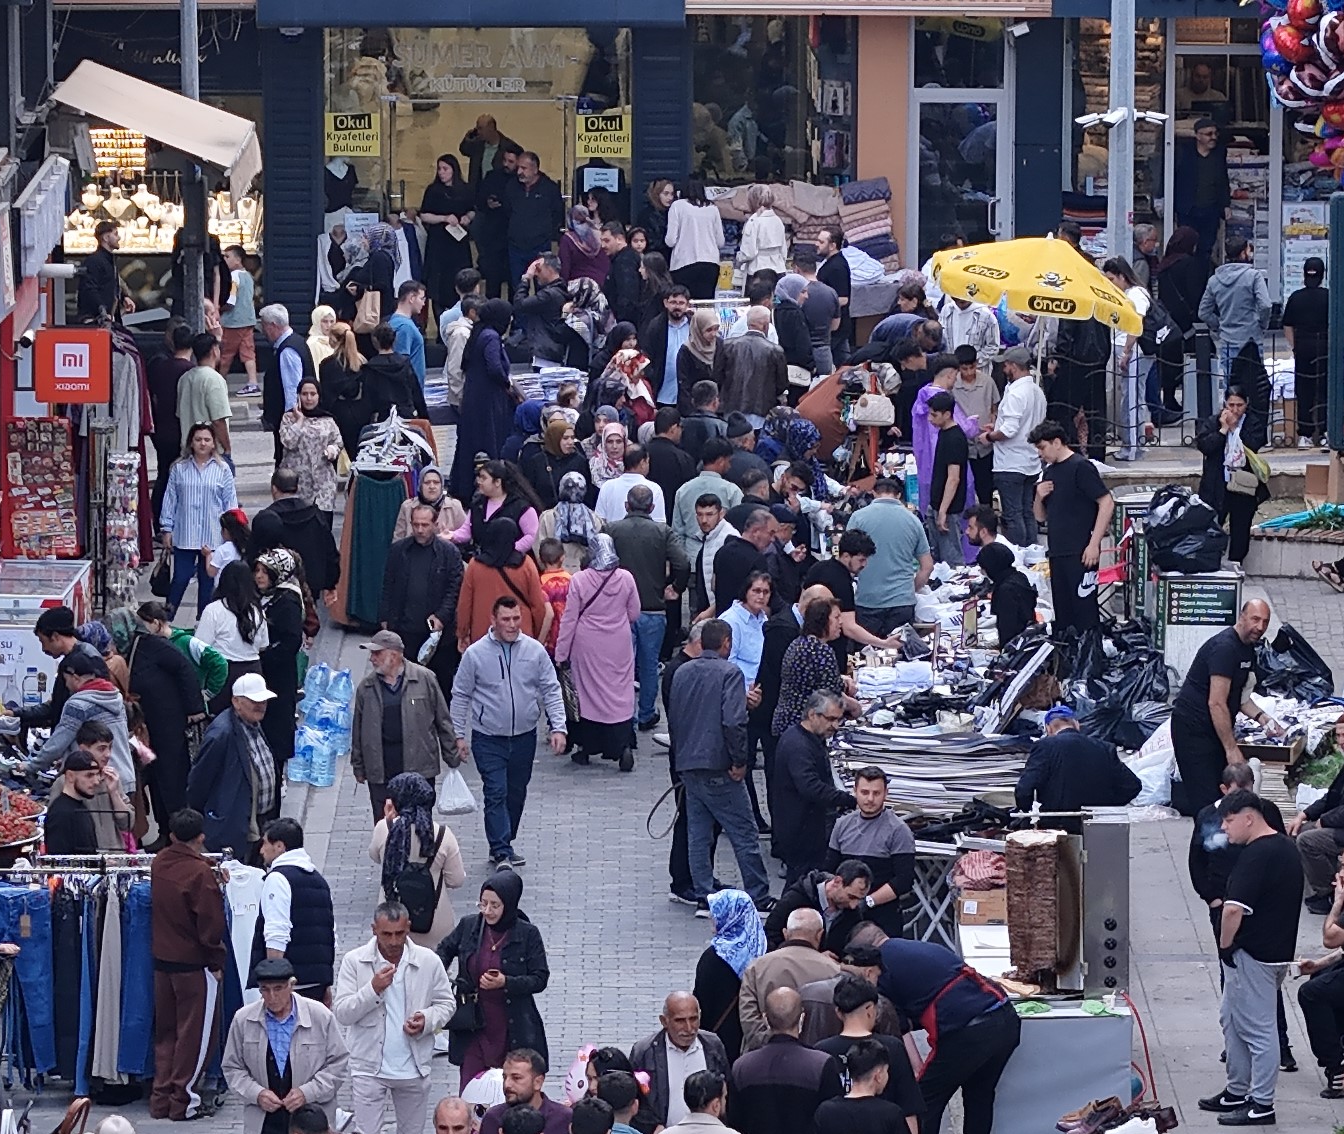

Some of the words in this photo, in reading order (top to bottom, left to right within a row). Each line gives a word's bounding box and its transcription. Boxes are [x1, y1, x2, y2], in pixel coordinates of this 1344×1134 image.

[393, 40, 493, 69] SÜMER
[498, 44, 566, 69] AVM
[429, 74, 528, 93] KÜTÜKLER
[336, 114, 370, 130] Okul
[587, 117, 621, 131] Okul
[326, 131, 379, 144] Kıyafetleri
[577, 132, 630, 145] Kıyafetleri
[333, 143, 372, 154] Bulunur
[583, 145, 624, 155] Bulunur
[55, 382, 90, 391] xiaomi
